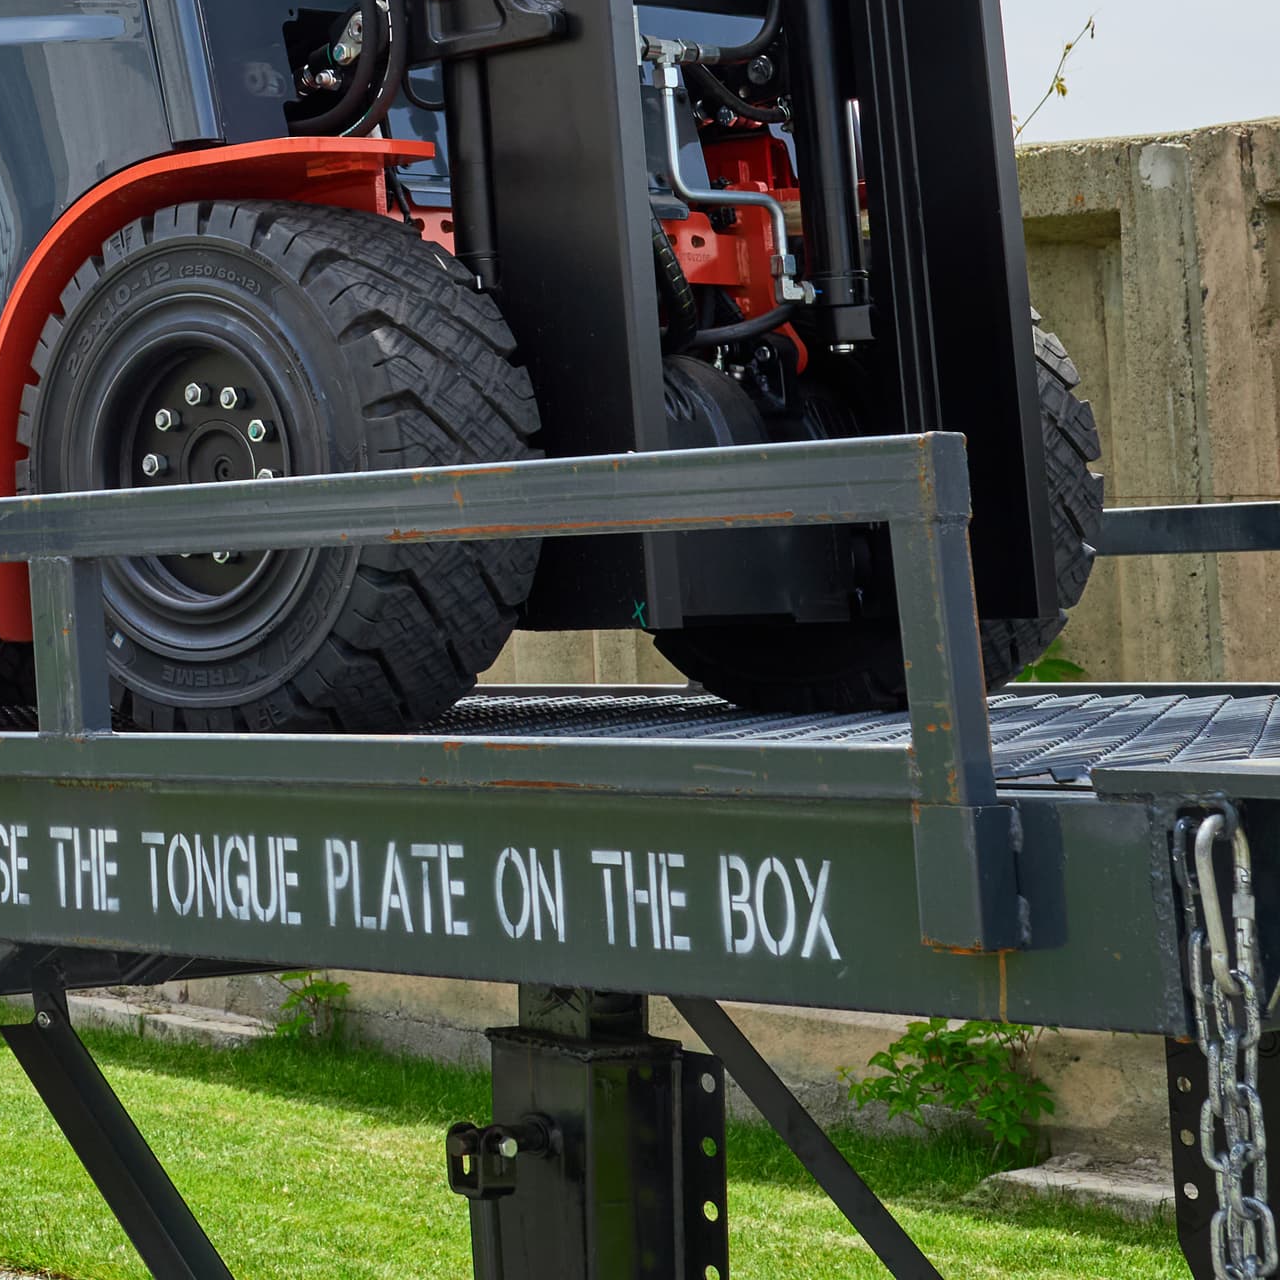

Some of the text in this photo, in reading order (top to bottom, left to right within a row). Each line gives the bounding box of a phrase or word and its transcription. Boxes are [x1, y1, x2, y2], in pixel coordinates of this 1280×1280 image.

[49, 827, 121, 912] THE
[140, 831, 303, 926] TONGUE
[324, 839, 470, 937] PLATE
[494, 846, 567, 944] ON
[590, 850, 692, 951] THE
[718, 854, 842, 963] BOX
